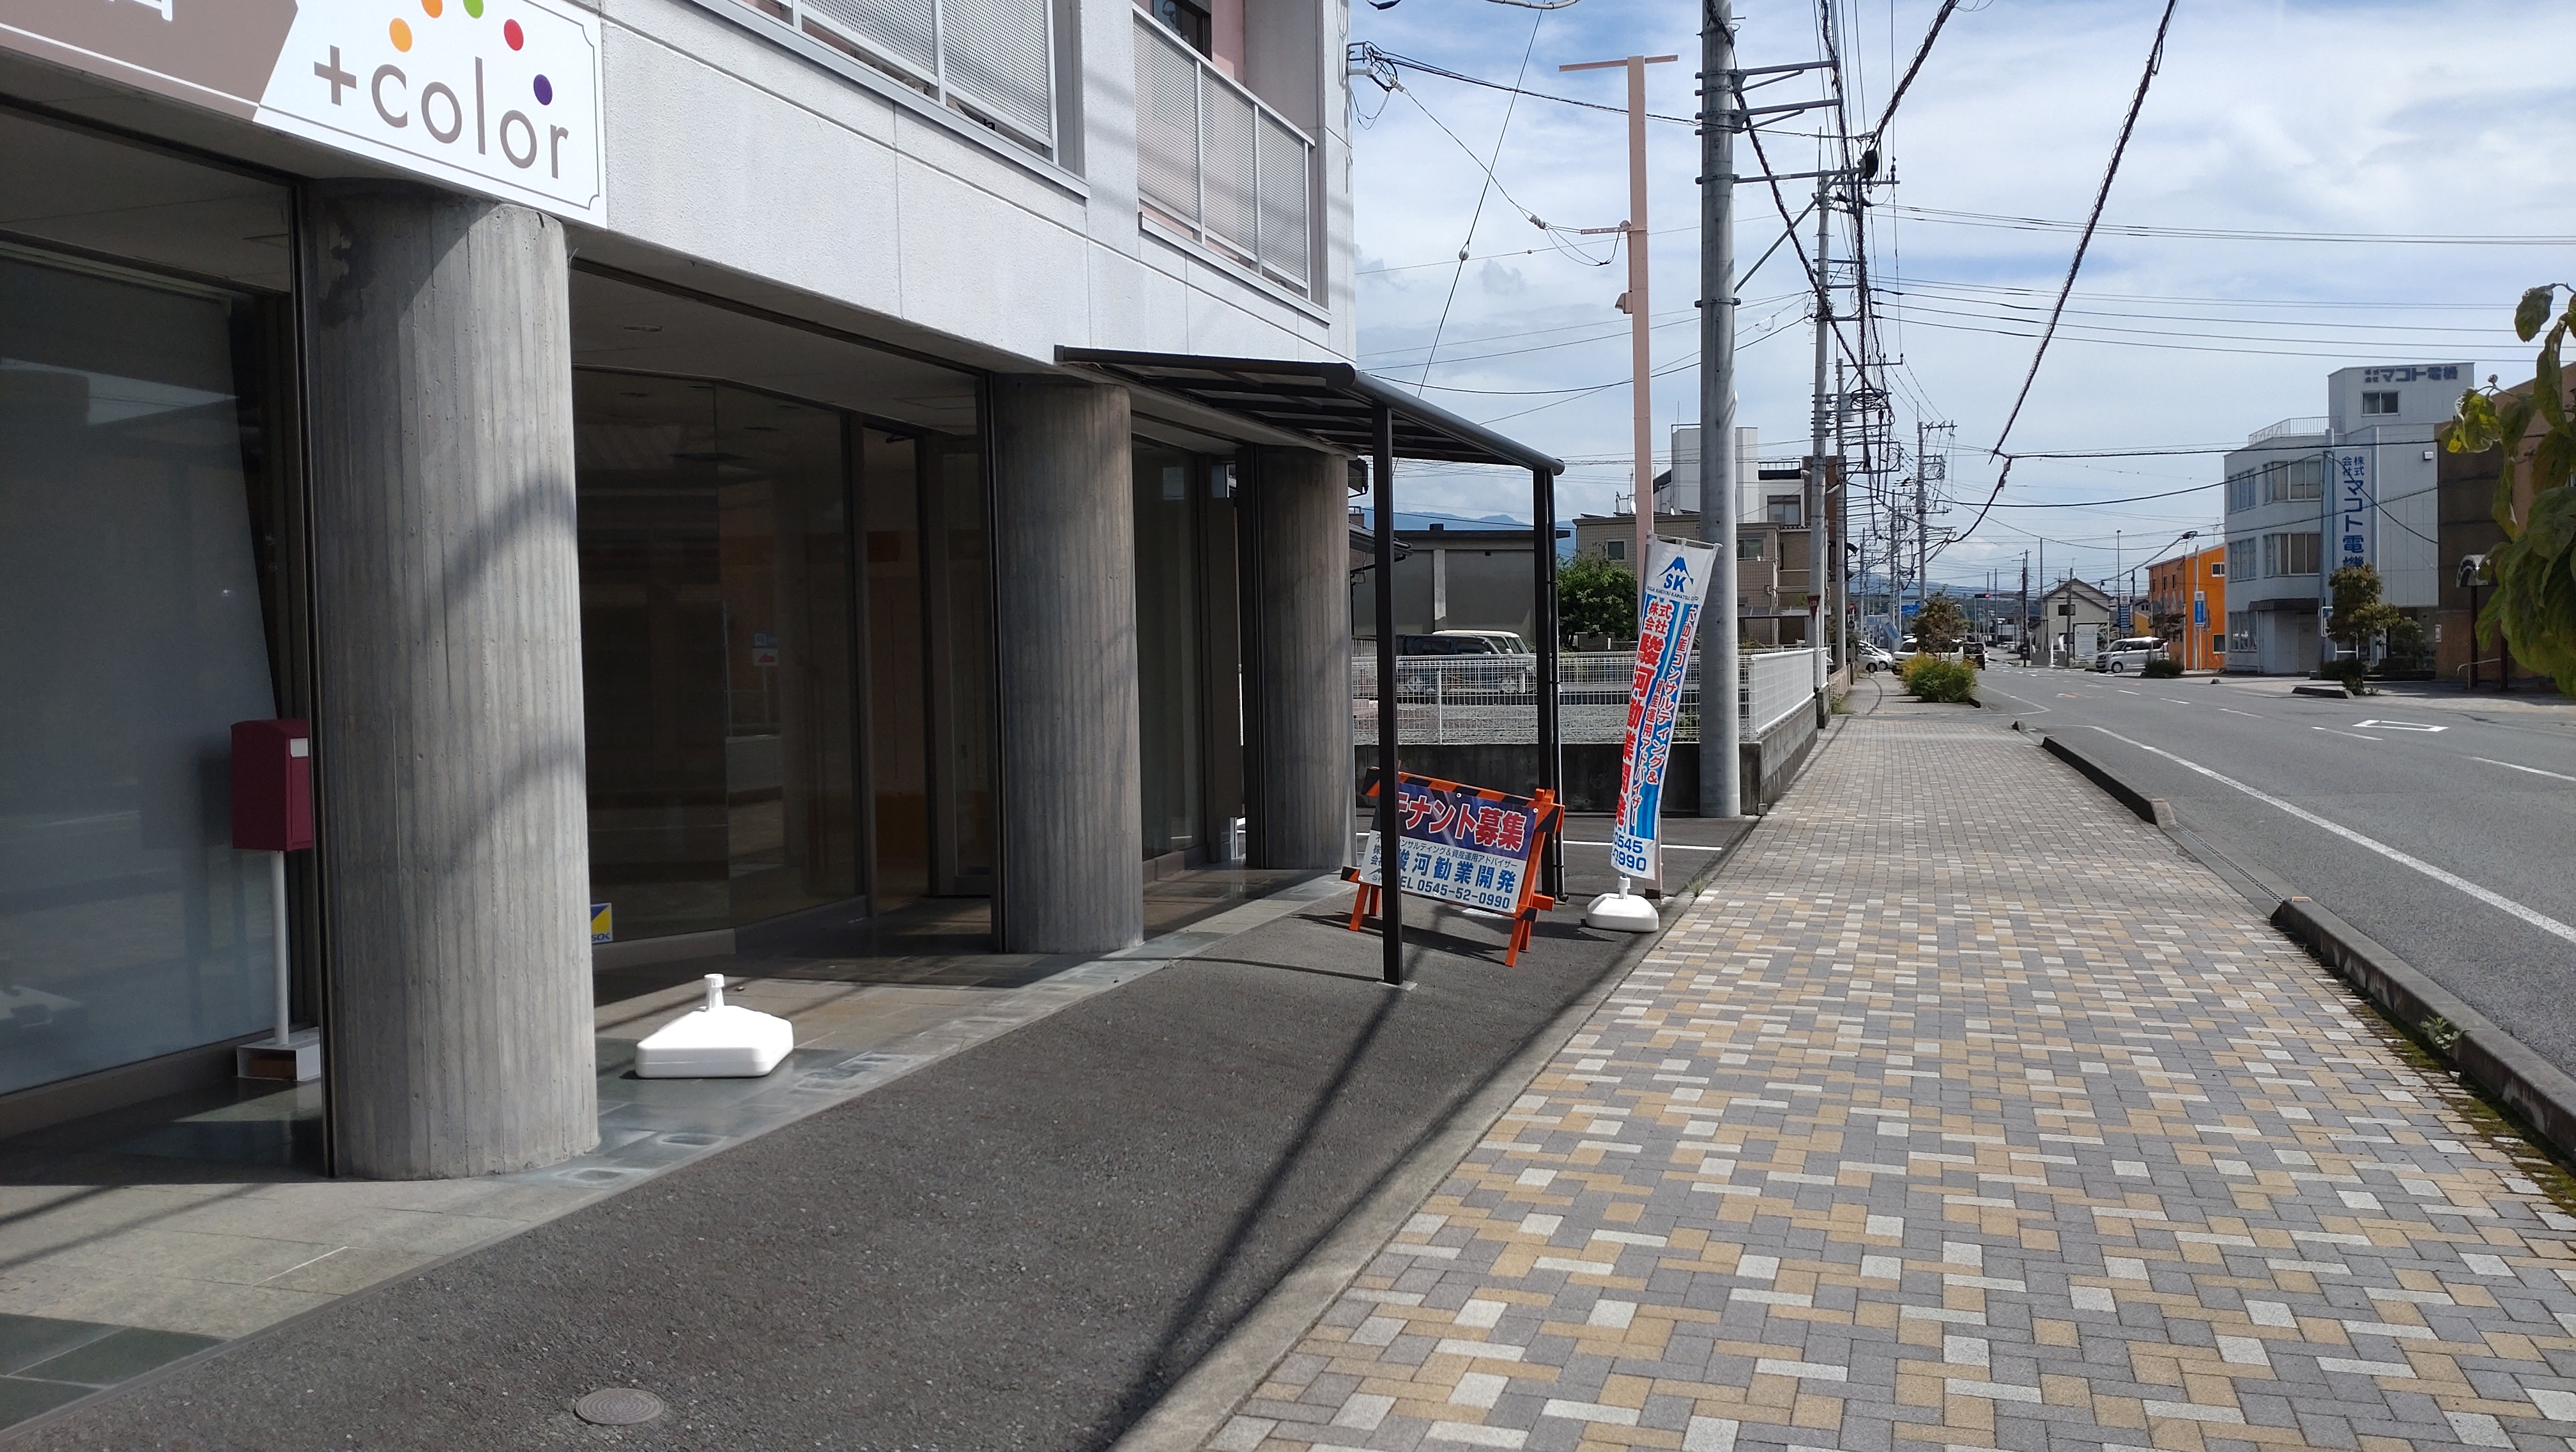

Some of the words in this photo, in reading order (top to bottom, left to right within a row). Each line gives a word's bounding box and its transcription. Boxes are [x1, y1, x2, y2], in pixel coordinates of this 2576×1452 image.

[1664, 573, 1686, 592] SK
[1648, 601, 1673, 619] 株式
[1644, 617, 1668, 633] 会社
[1400, 876, 1413, 889] EL
[1417, 880, 1510, 909] 0545-52-0990
